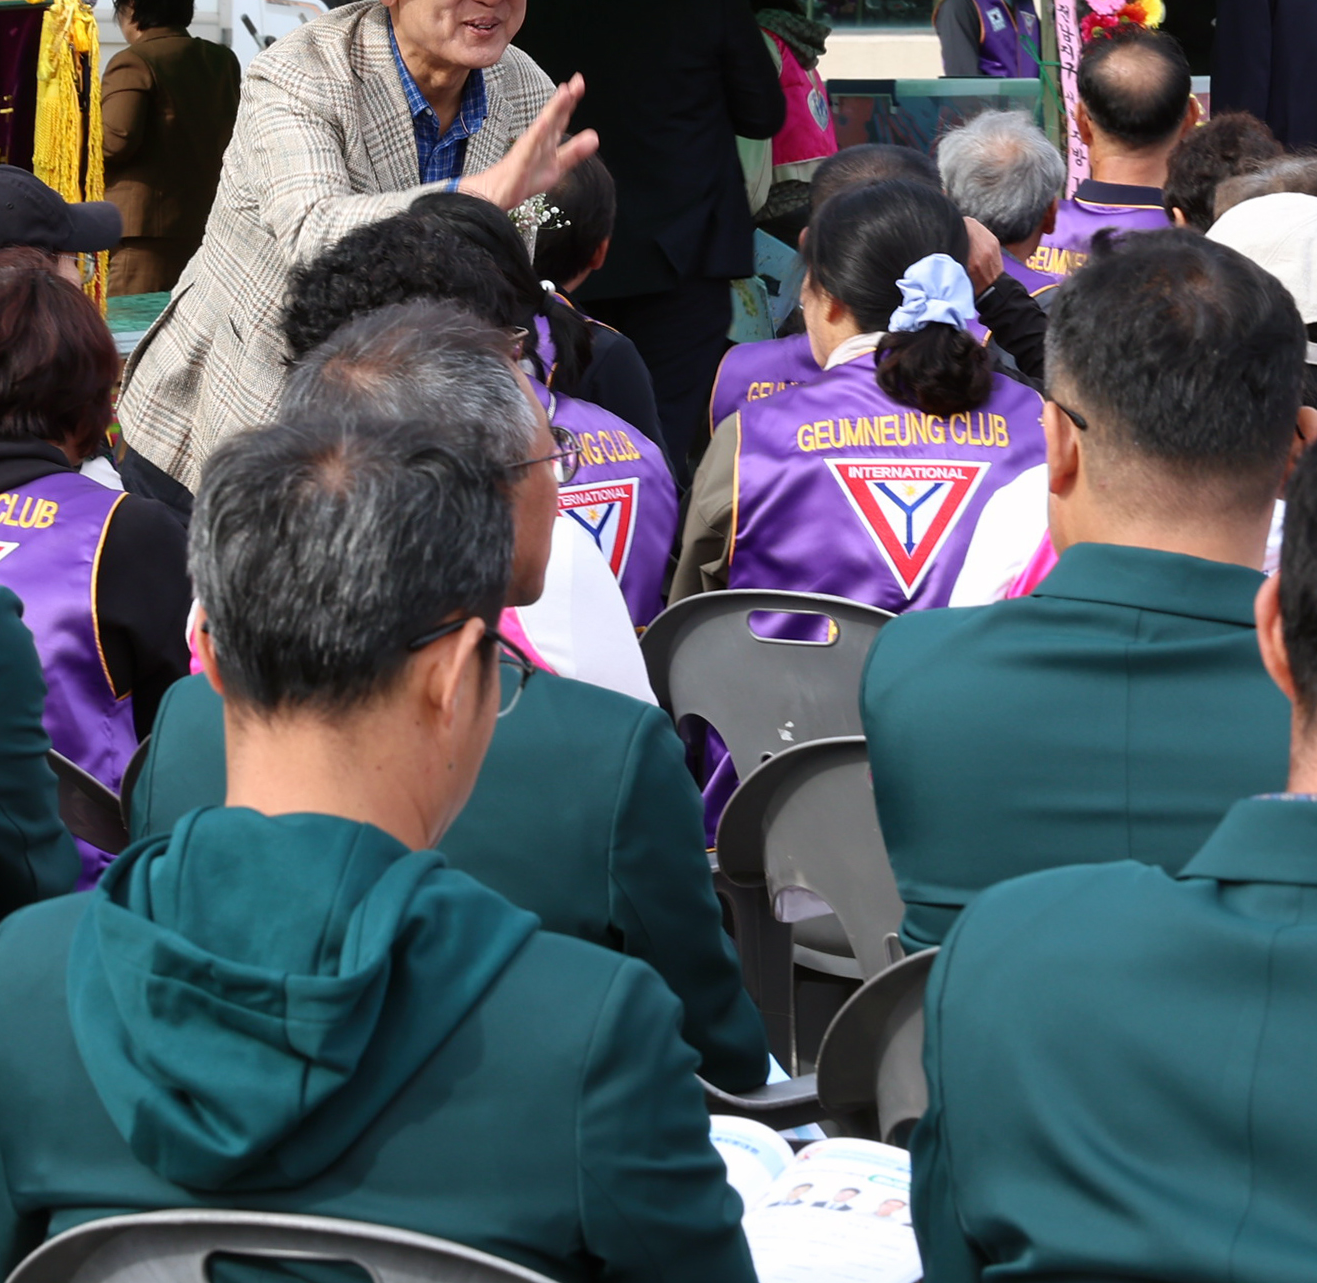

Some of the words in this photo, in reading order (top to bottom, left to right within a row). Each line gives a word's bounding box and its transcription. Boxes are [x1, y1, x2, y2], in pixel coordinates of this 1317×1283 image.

[797, 412, 946, 452] GEUMNEUNG
[949, 410, 1010, 448] CLUB
[599, 429, 641, 464] CLUB
[848, 465, 967, 481] INTERNATIONAL
[557, 487, 630, 510] TERNATIONAL
